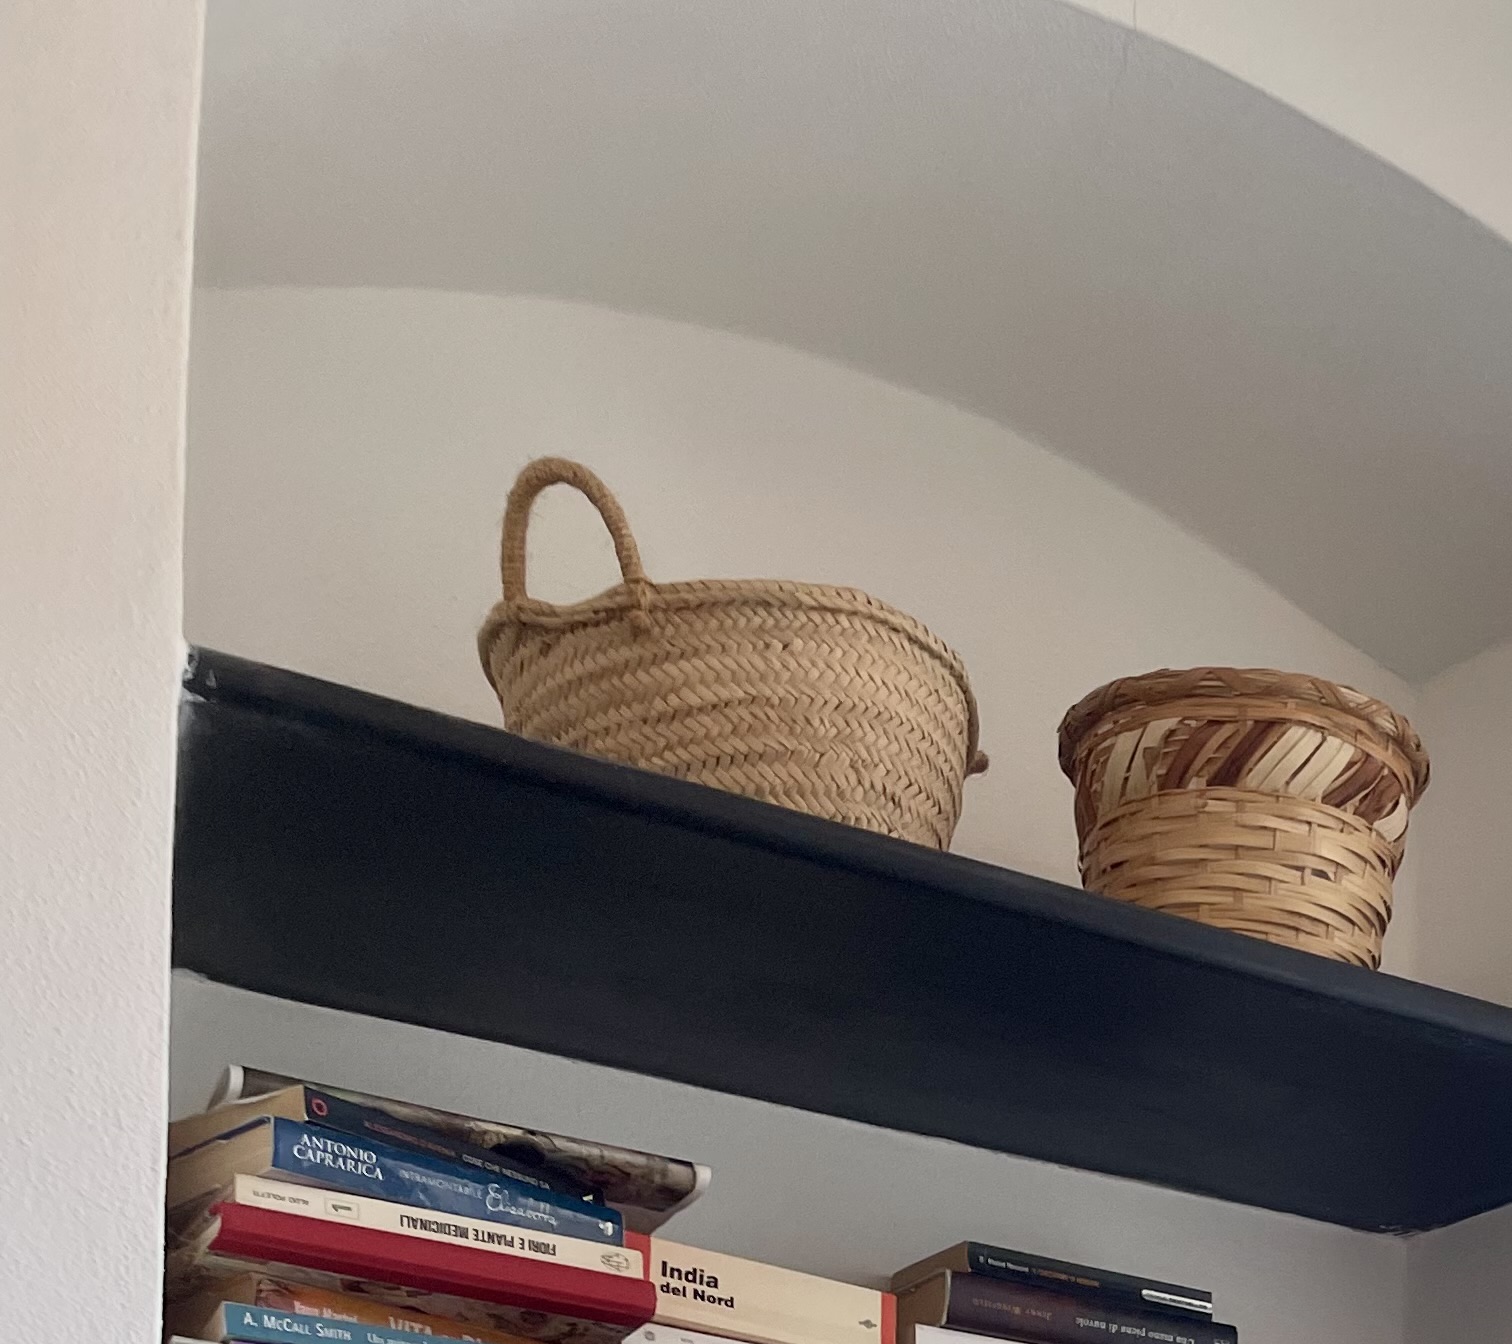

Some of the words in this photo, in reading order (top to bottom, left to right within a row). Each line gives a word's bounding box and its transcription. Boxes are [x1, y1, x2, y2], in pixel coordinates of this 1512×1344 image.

[301, 1133, 377, 1164] ANTONIO
[293, 1144, 384, 1181] CAPRARICA
[400, 1214, 470, 1241] MEDICINALI
[472, 1228, 515, 1249] PIANTE
[518, 1236, 526, 1250] E
[528, 1239, 557, 1257] FIORI
[661, 1260, 719, 1289] India
[660, 1282, 687, 1298] del
[693, 1288, 735, 1309] Nord
[243, 1312, 258, 1328] A.
[1108, 1320, 1119, 1335] di
